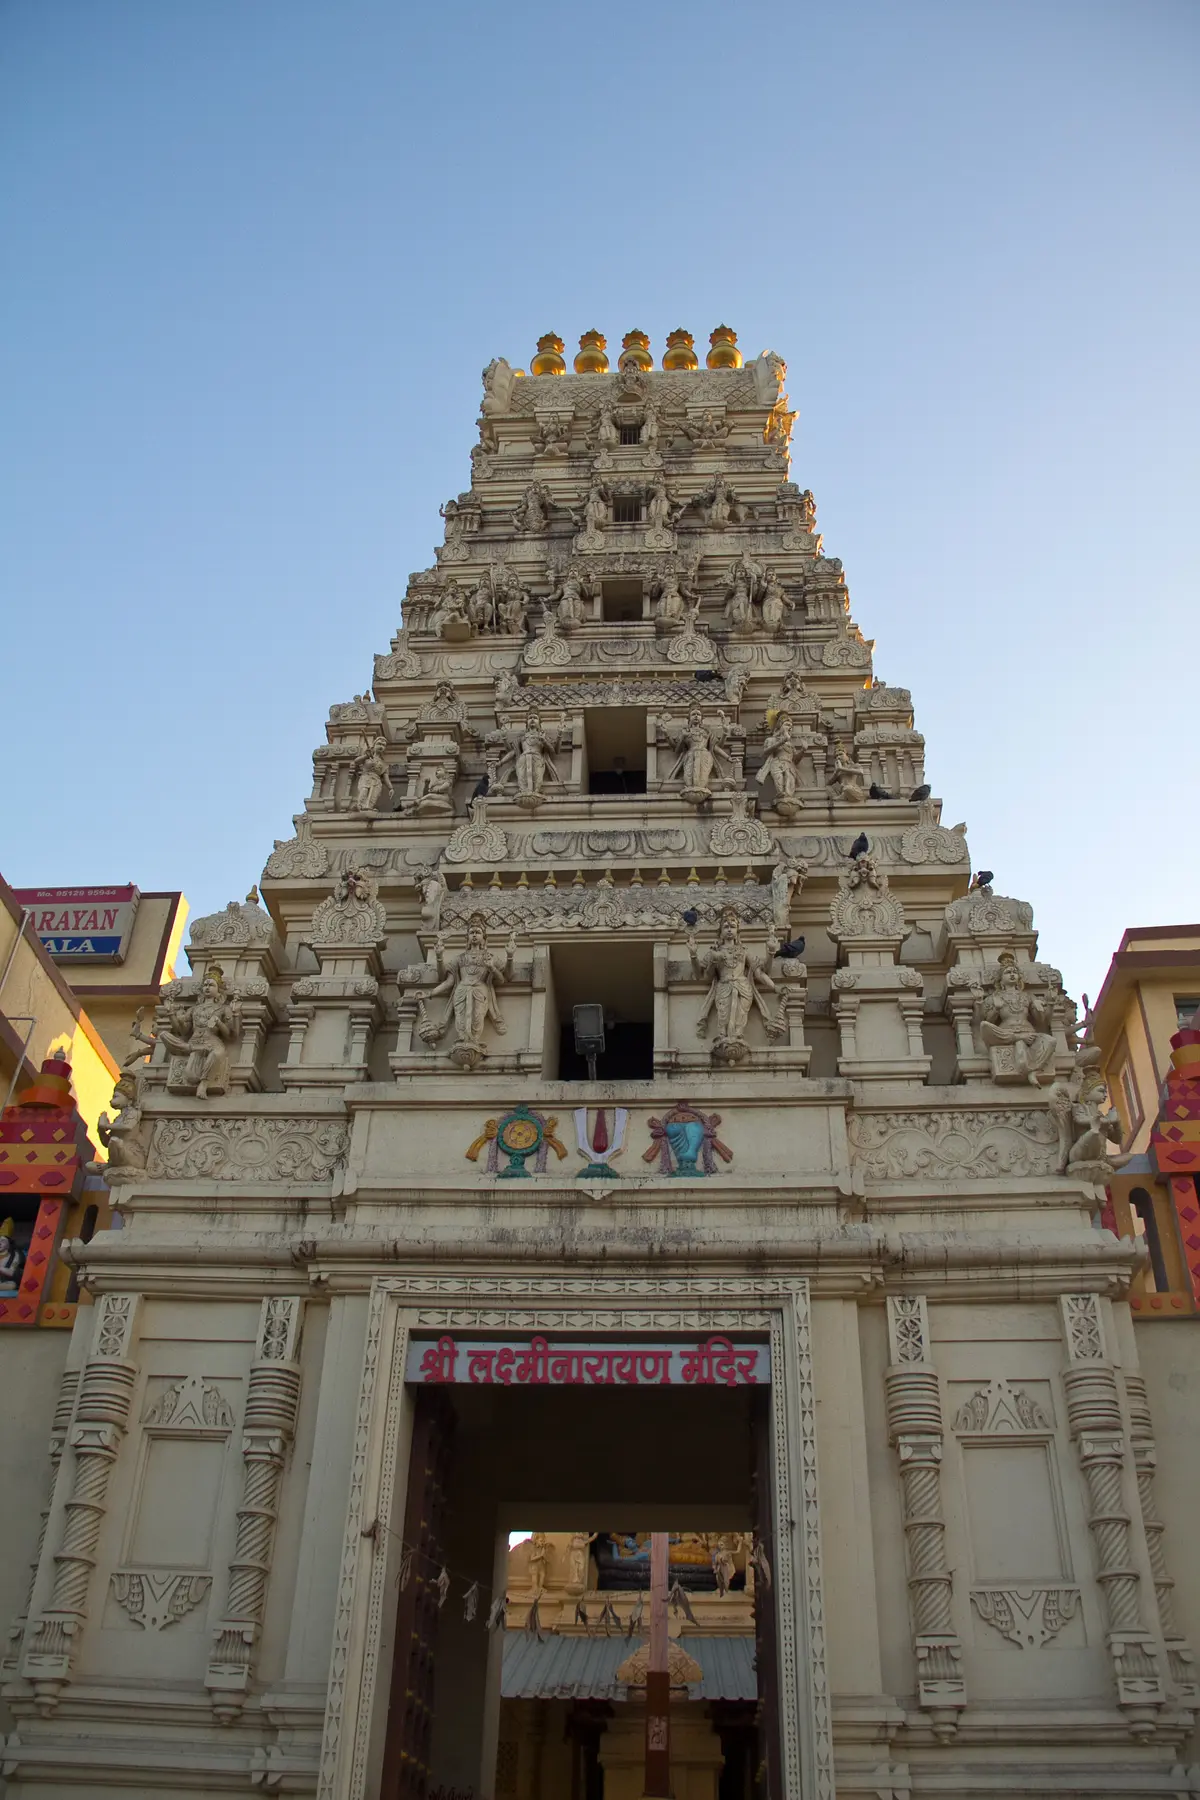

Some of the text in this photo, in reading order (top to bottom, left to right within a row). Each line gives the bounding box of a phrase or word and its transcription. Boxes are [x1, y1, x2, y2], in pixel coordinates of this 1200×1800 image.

[420, 1335, 758, 1387] श्री लक्ष्मीनारायण मंदिर
